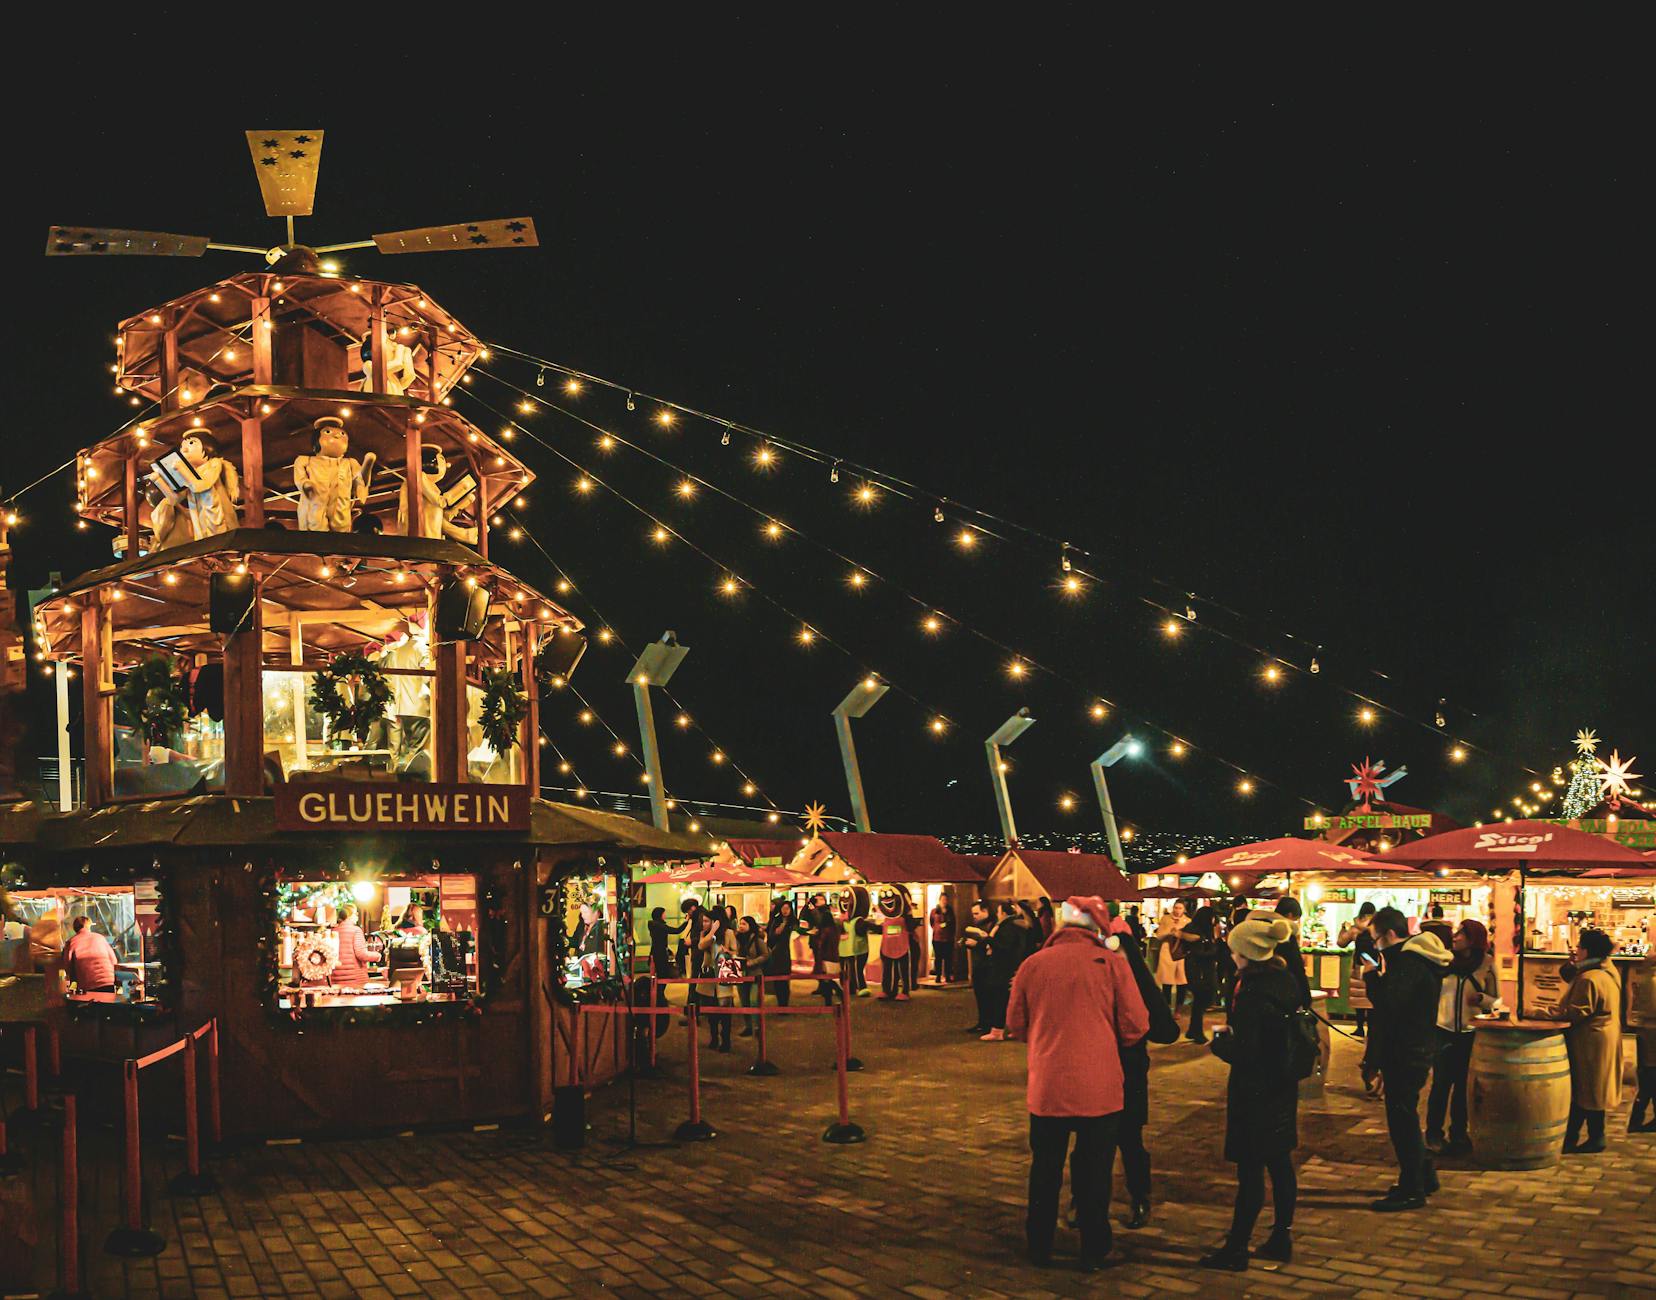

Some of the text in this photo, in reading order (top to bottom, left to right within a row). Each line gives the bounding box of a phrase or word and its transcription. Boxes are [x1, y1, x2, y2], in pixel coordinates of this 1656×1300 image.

[298, 792, 510, 823] GLUEHWEIN
[1306, 817, 1331, 829] DS
[1392, 814, 1430, 828] HAUS
[541, 889, 558, 914] 3
[633, 886, 643, 905] 4
[1430, 893, 1461, 903] HERE
